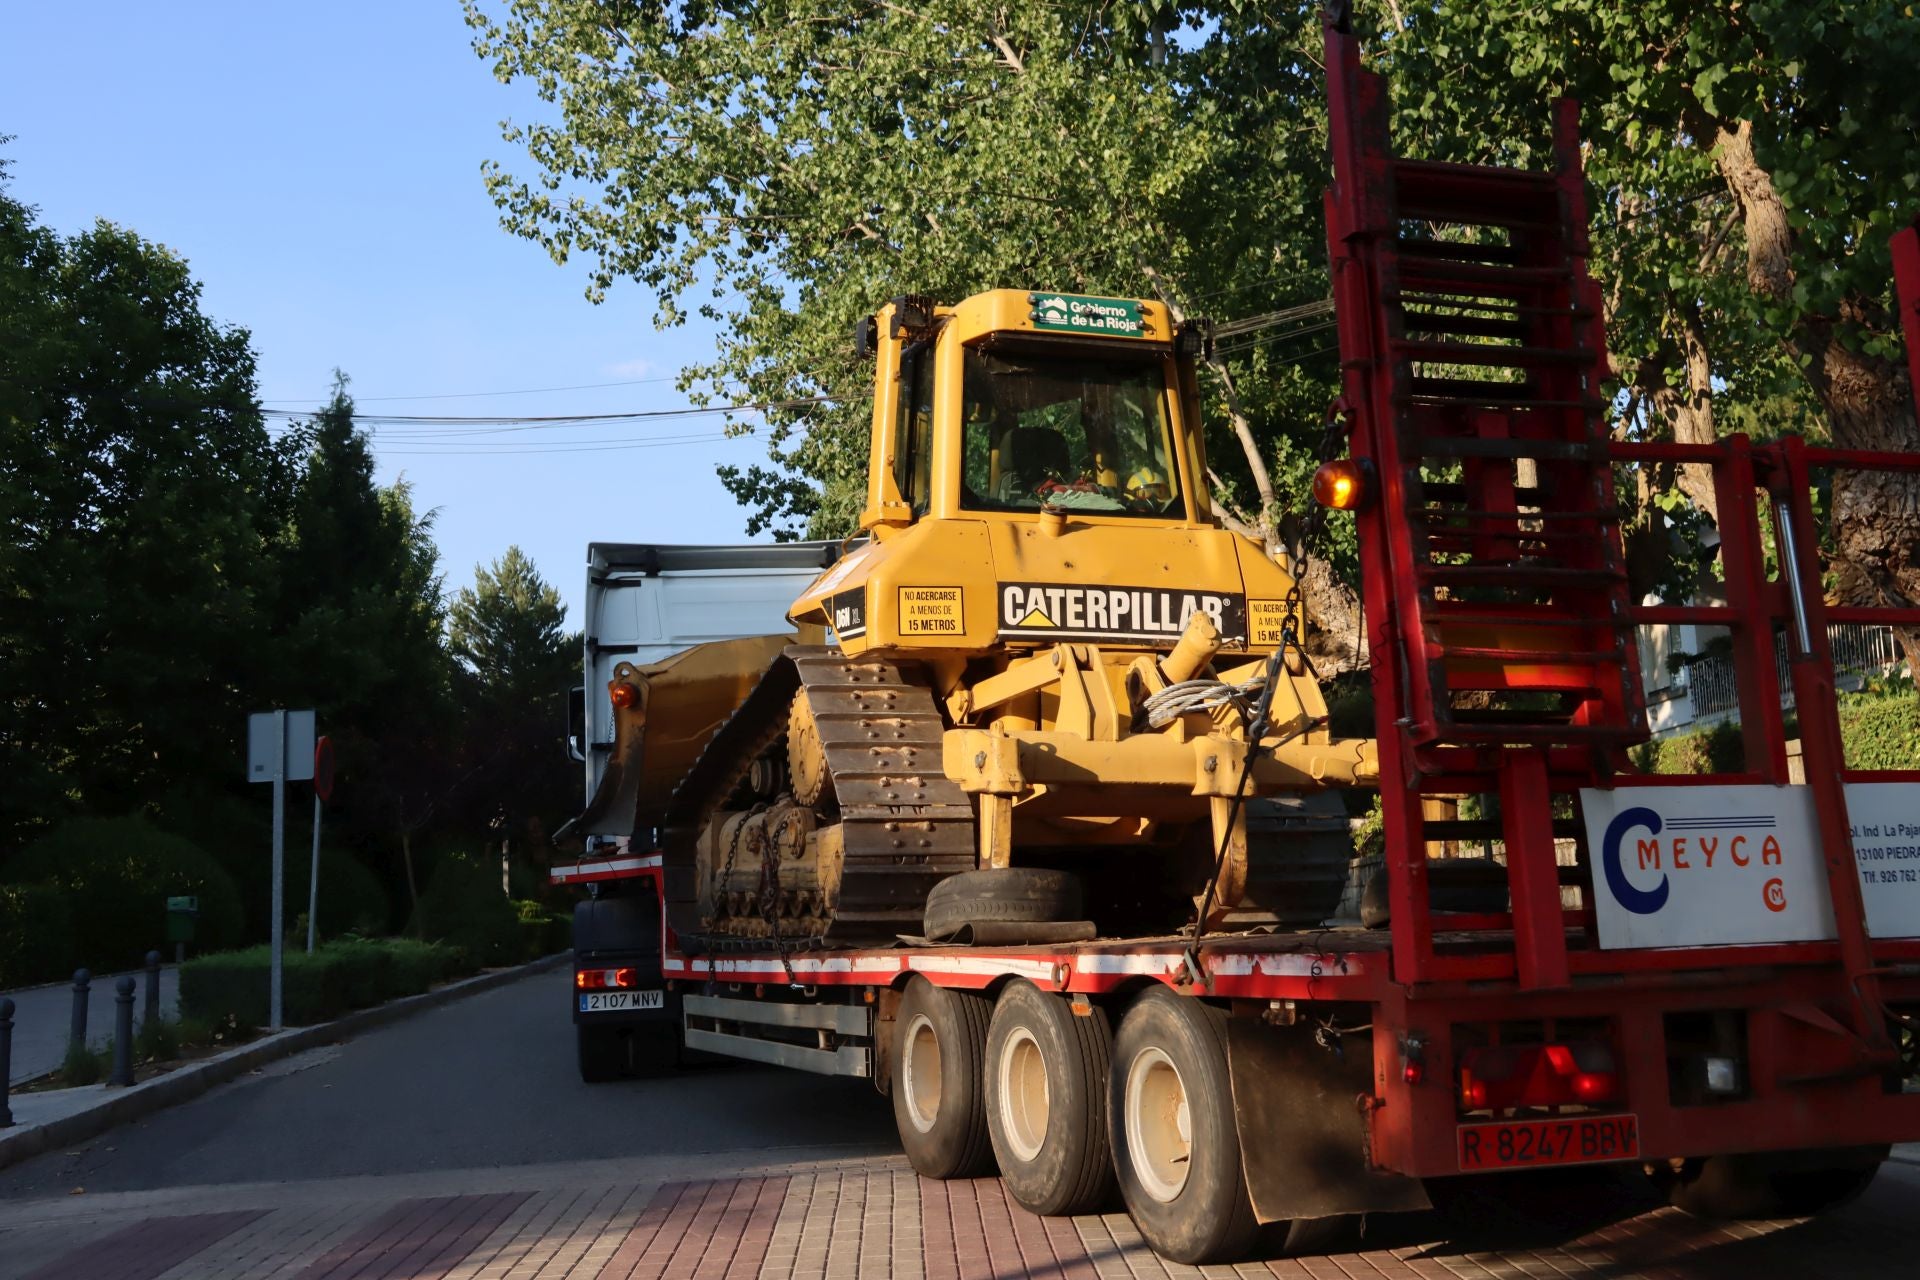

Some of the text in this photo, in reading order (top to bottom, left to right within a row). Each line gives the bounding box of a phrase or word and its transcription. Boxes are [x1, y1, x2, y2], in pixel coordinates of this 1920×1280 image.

[1071, 314, 1137, 332] de La Rioja
[904, 591, 957, 601] NO ACERCARSE
[910, 605, 953, 615] A MENOS DE
[1253, 603, 1300, 614] NO ACERCASE
[836, 606, 861, 629] D6N XL
[1258, 617, 1264, 626] A
[1264, 617, 1284, 626] MENO
[908, 619, 956, 631] 15 METROS
[1257, 630, 1267, 641] 15
[1862, 825, 1879, 837] Ind
[1884, 824, 1896, 837] La
[1898, 823, 1920, 839] Paja
[1856, 847, 1884, 861] 13100
[1880, 870, 1898, 883] 926
[1899, 869, 1917, 882] 762
[591, 992, 659, 1009] 2107 MNV
[1497, 1124, 1573, 1163] 8247
